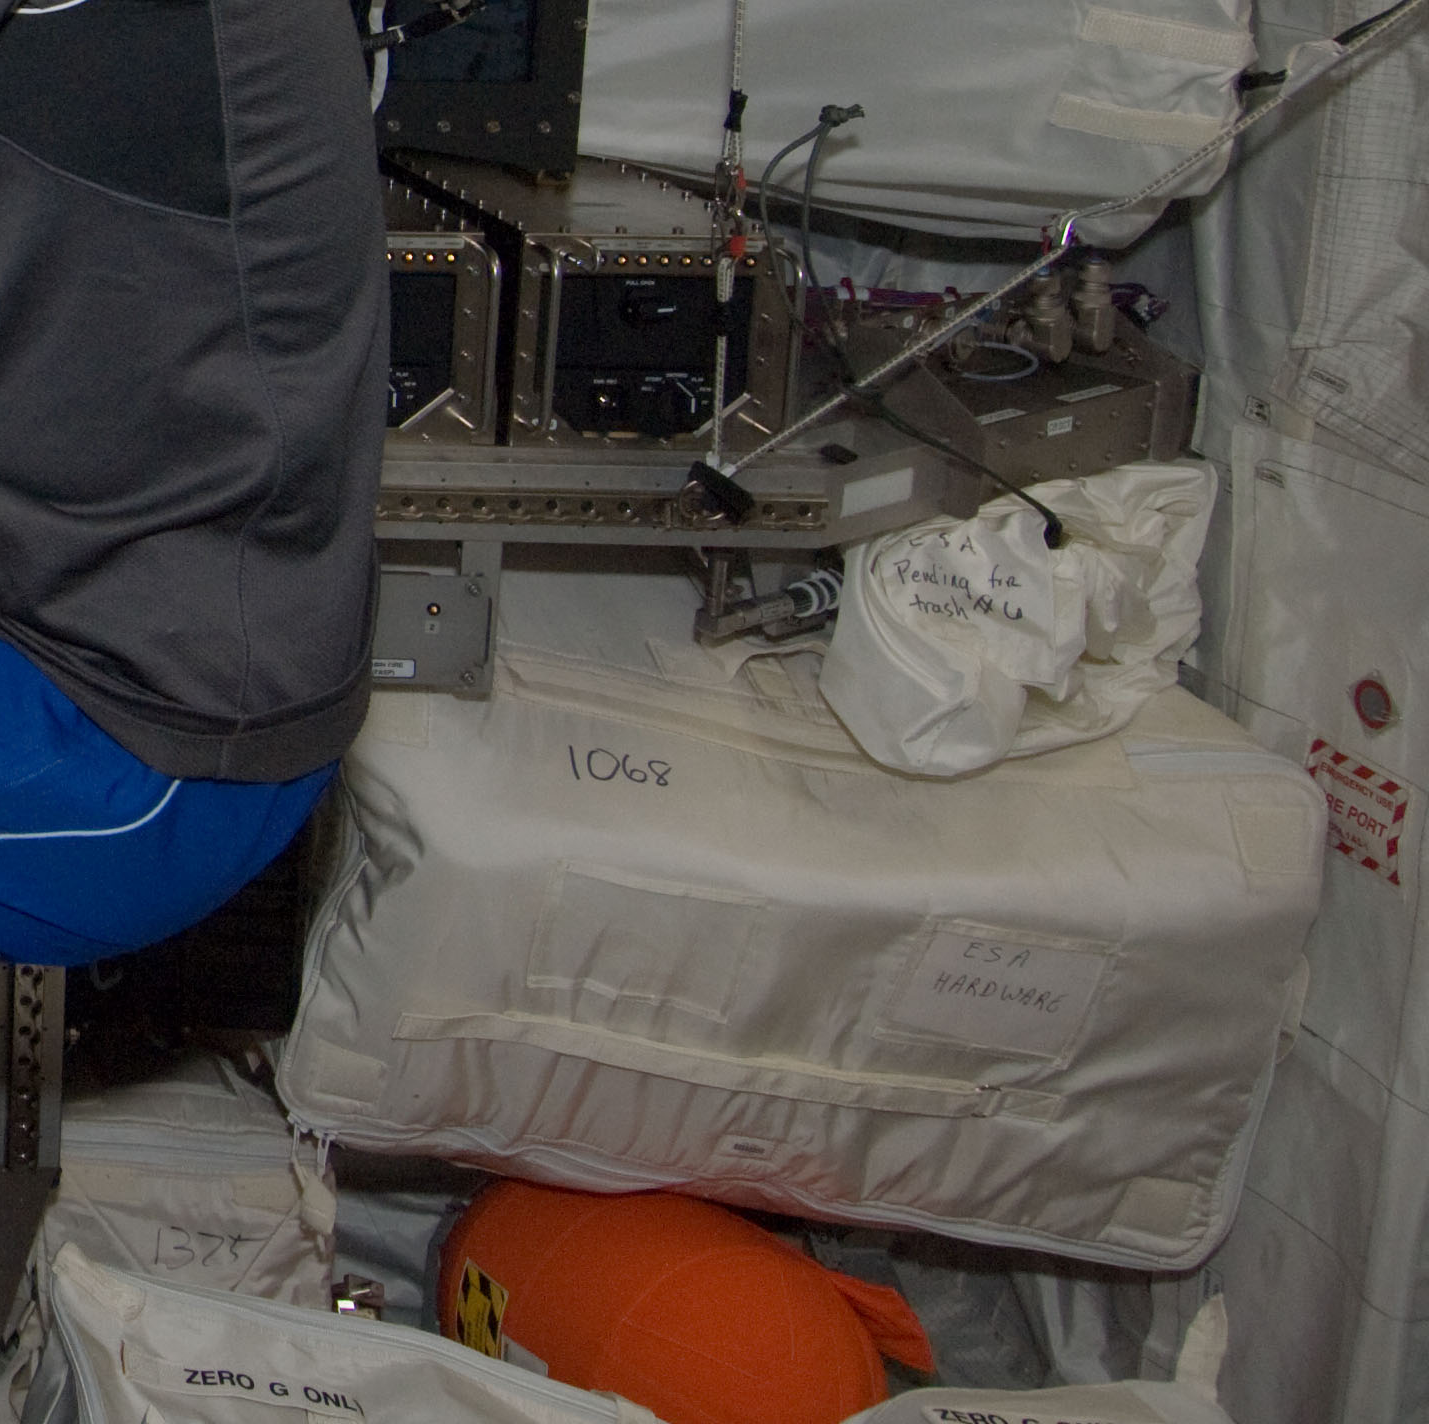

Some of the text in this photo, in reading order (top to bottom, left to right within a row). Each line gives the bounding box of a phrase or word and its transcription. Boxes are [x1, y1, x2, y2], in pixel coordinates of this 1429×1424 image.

[893, 558, 972, 600] Pending
[908, 593, 969, 621] trash
[568, 744, 672, 787] 1068
[1346, 805, 1388, 838] PORT
[932, 970, 1069, 1015] HARDWARE
[183, 1368, 256, 1391] ZERO
[268, 1382, 290, 1397] G
